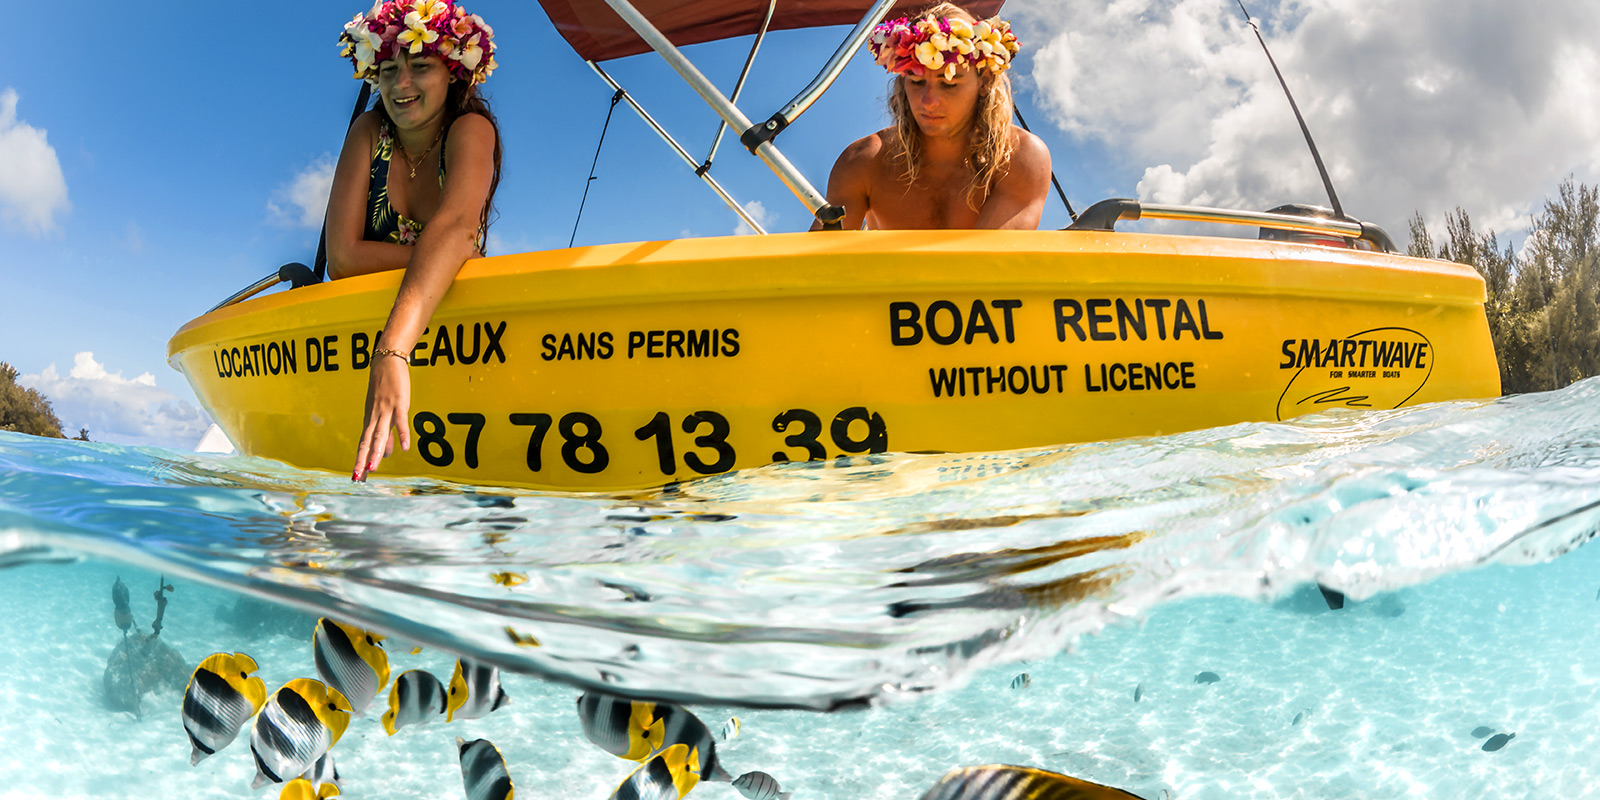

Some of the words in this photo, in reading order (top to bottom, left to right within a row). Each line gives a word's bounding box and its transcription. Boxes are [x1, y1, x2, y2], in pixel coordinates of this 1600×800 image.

[889, 299, 1023, 347] BOAT
[1053, 297, 1224, 343] RENTAL
[213, 338, 297, 379] LOCATION
[305, 334, 340, 373] DE
[351, 320, 507, 370] BEAUX
[540, 331, 614, 361] SANS
[627, 328, 740, 359] PERMIS
[1279, 339, 1428, 369] SMARTWAVE
[928, 364, 1068, 398] WITHOUT
[1084, 361, 1196, 393] LICENCE
[1329, 370, 1343, 379] FOR
[1347, 370, 1376, 378] SMARTER
[1382, 370, 1401, 378] BOATS
[413, 411, 487, 470] 87
[508, 411, 610, 475] 78
[634, 410, 736, 475] 13
[771, 406, 888, 462] 39
